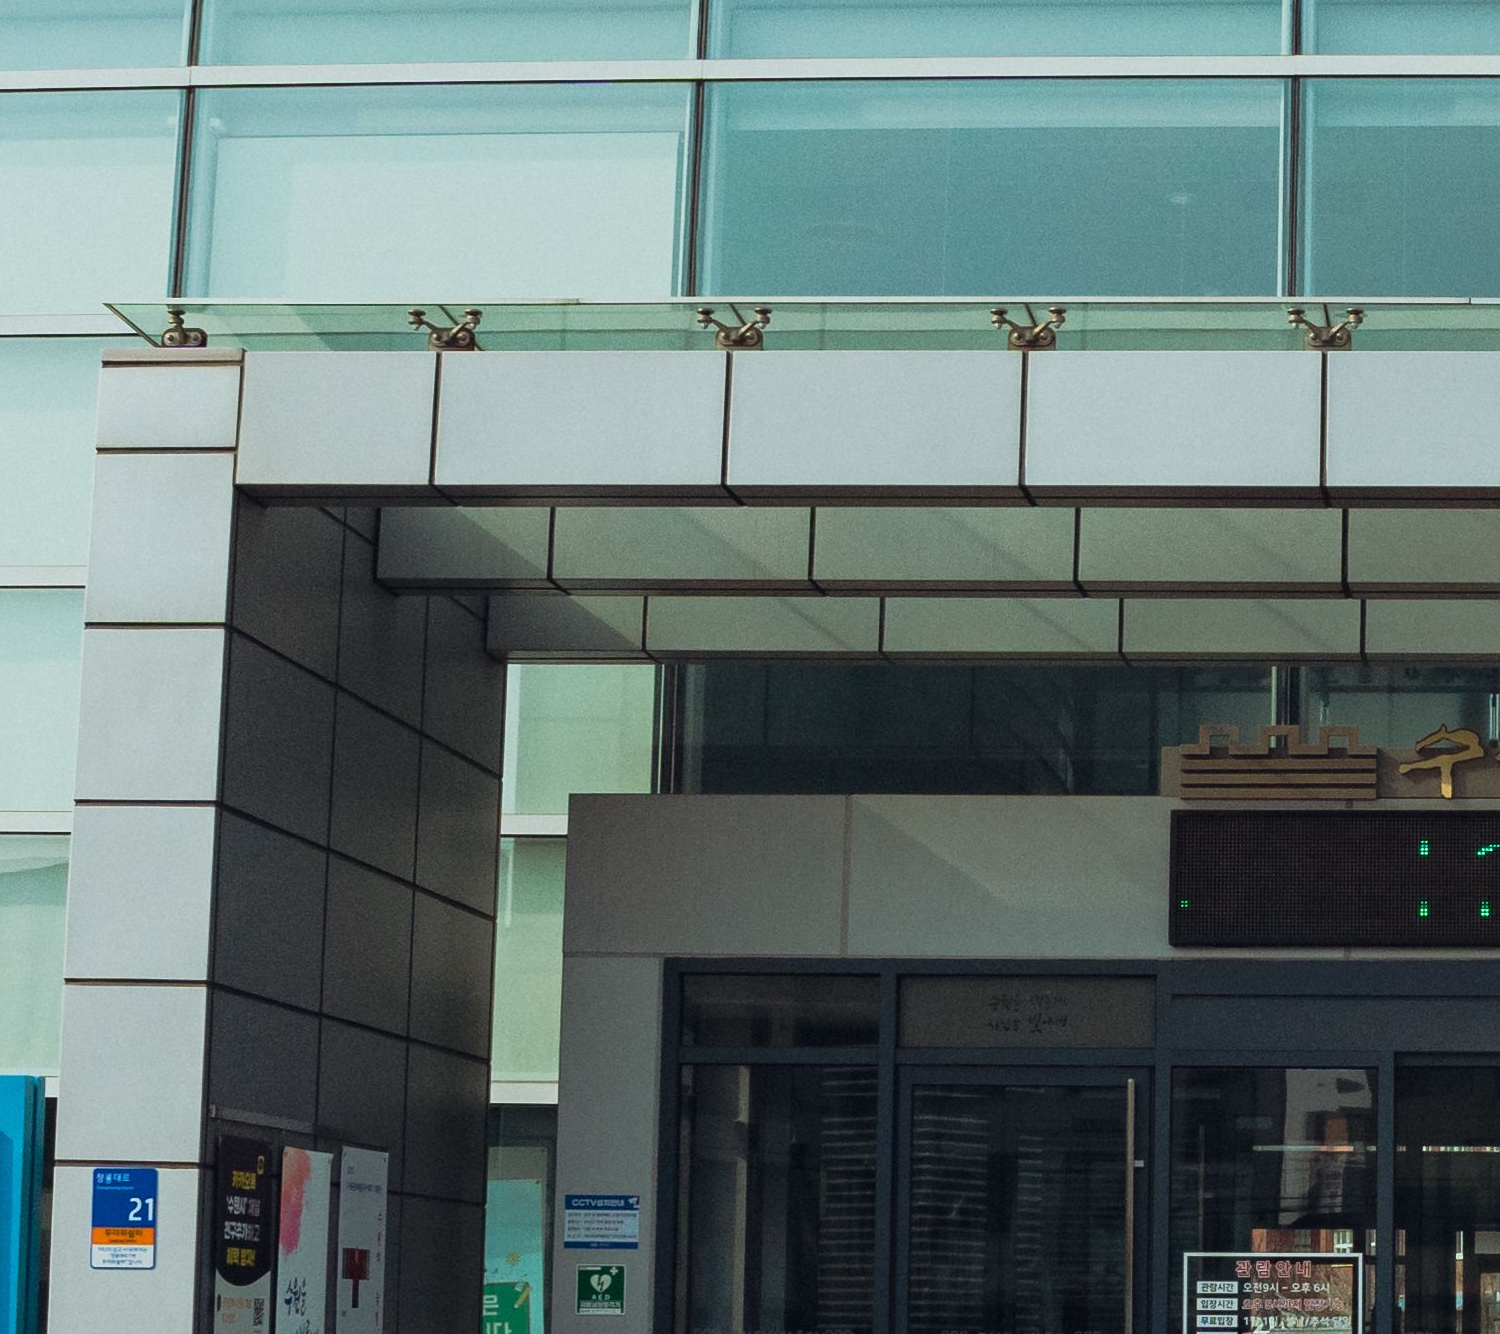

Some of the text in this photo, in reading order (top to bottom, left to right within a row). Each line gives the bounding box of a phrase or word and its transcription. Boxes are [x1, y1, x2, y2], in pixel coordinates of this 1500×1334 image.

[128, 1197, 154, 1221] 21
[1201, 1283, 1234, 1293] 관람시간
[1243, 1283, 1279, 1294] 오전9시
[1291, 1283, 1310, 1294] 오후
[1313, 1283, 1330, 1293] 6시
[1201, 1300, 1234, 1309] 입장시간
[1200, 1316, 1234, 1326] 무료입장
